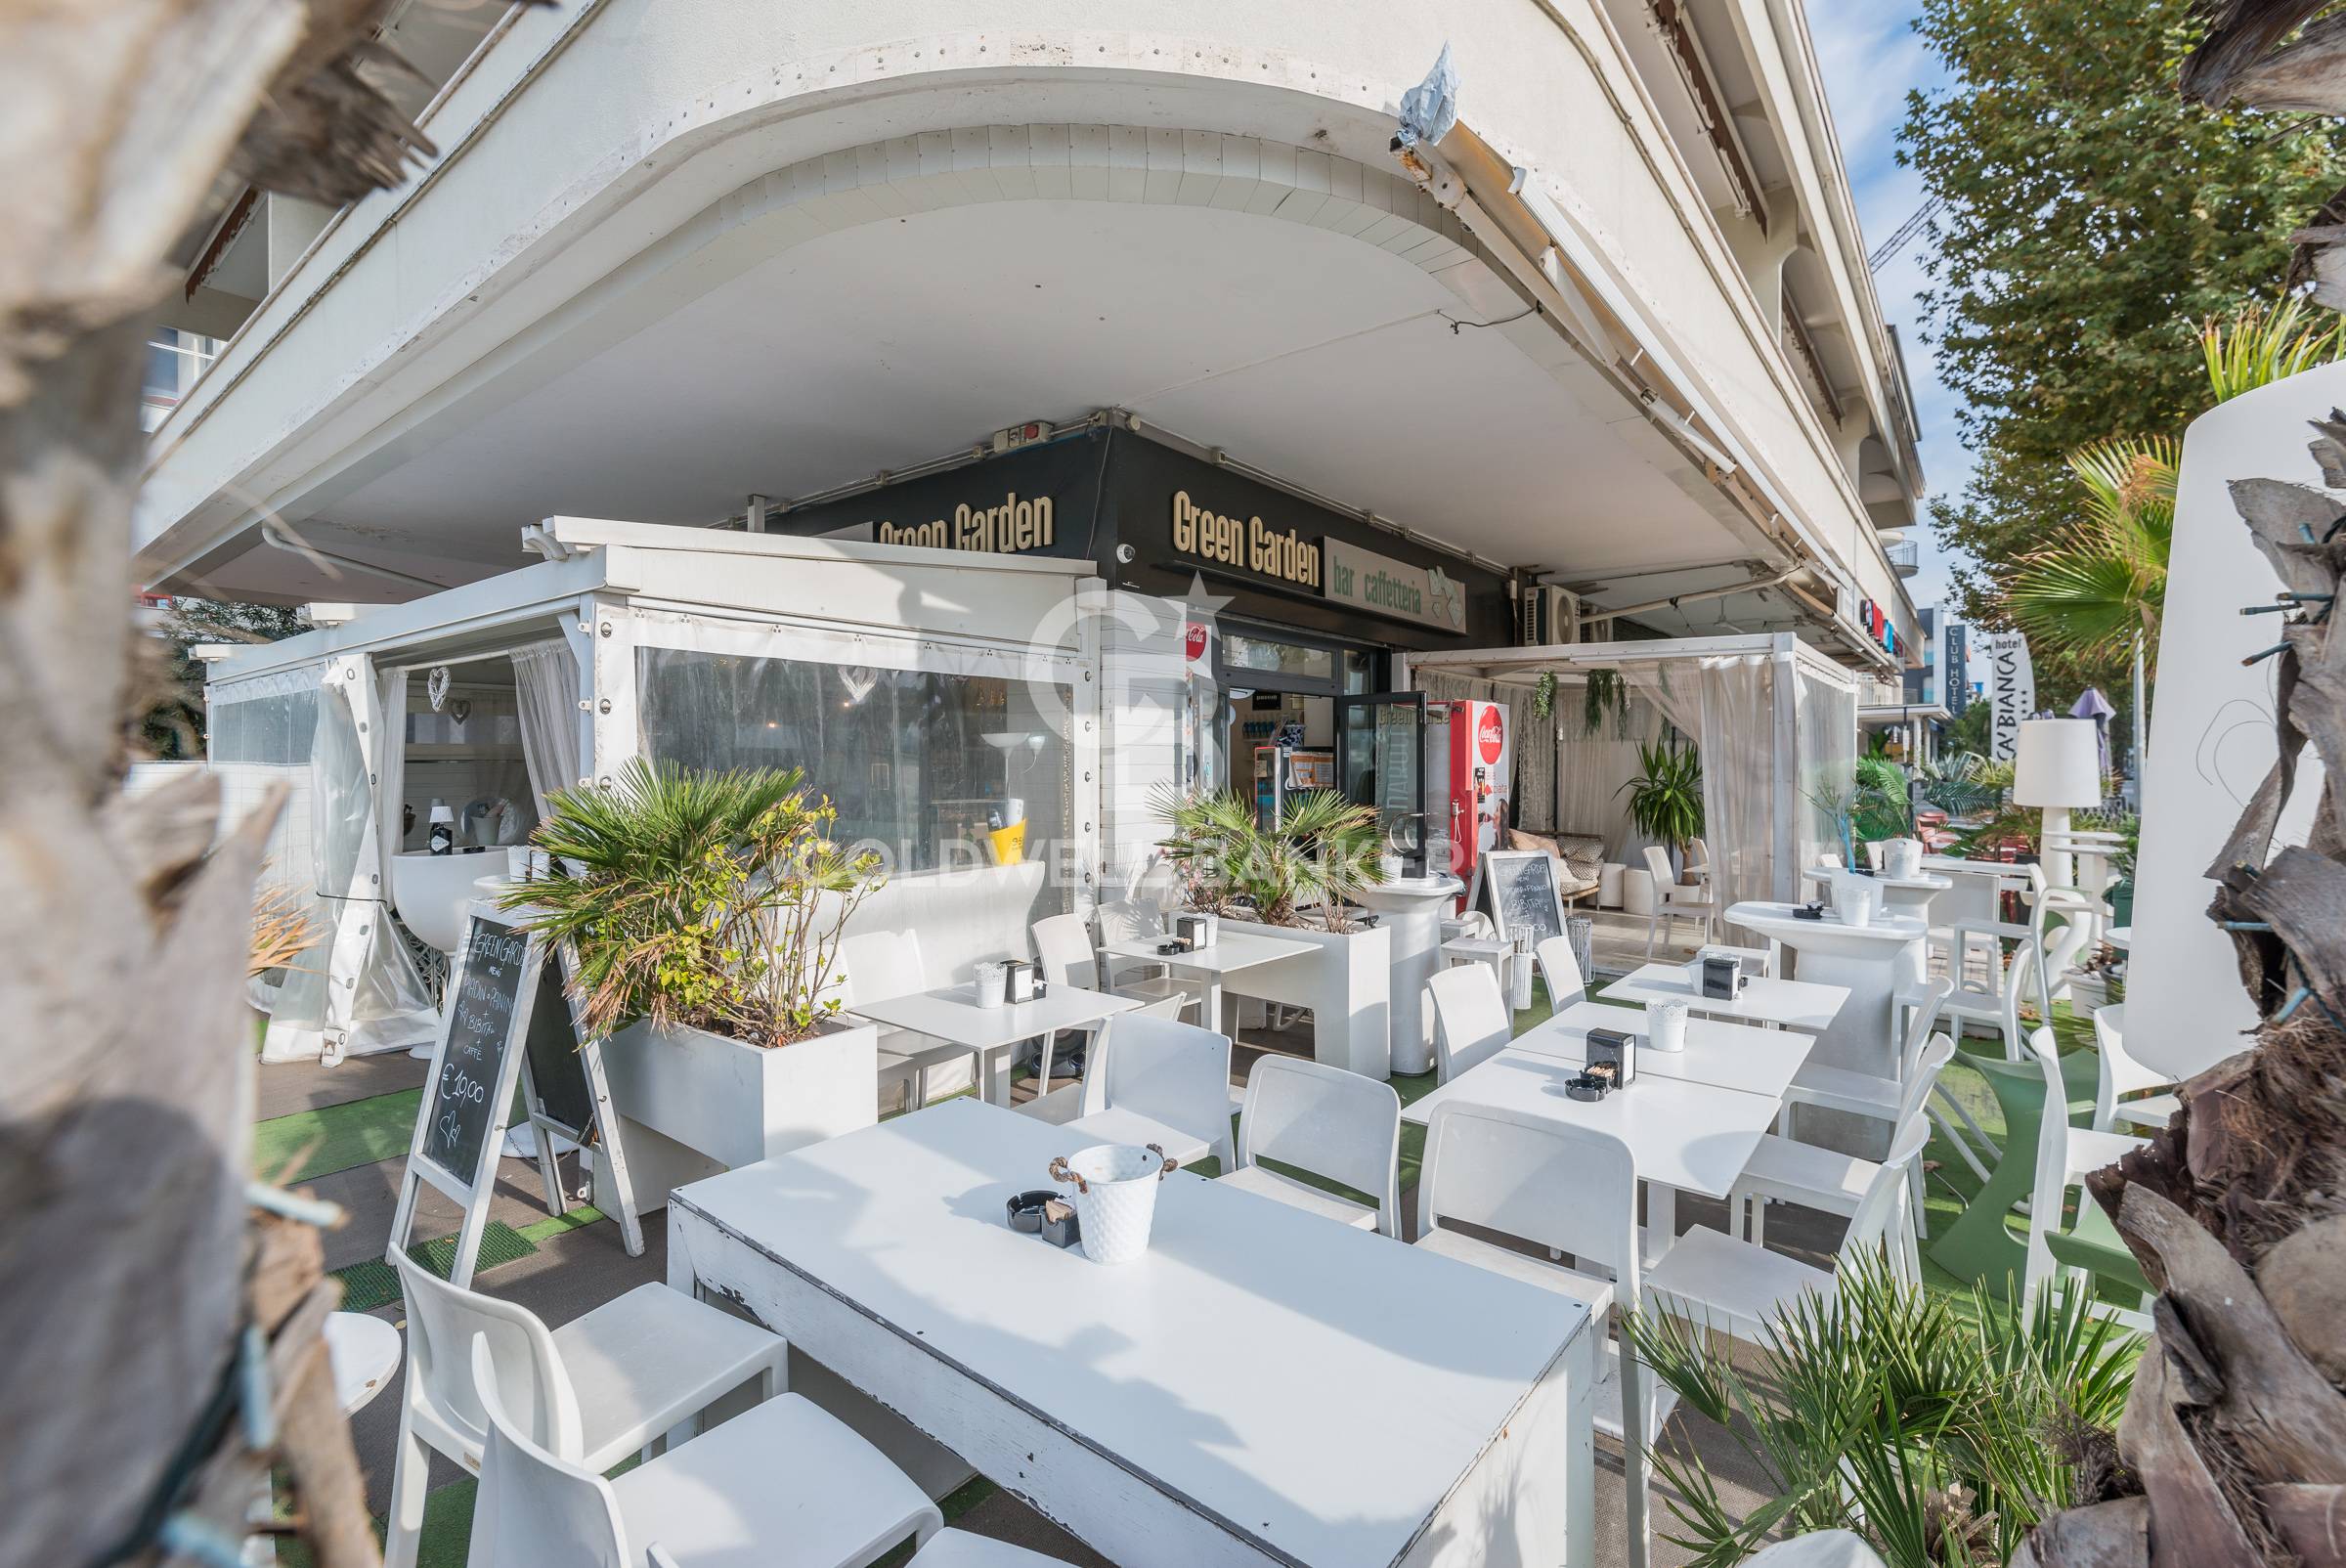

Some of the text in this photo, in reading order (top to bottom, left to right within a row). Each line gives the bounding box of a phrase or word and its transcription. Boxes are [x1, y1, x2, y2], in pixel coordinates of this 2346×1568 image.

[955, 492, 1053, 554] Garden
[1173, 490, 1320, 587] Green Garden
[1333, 554, 1422, 615] bar caffetteria
[1949, 627, 1959, 664] CLUB
[1995, 637, 2022, 650] hotel
[1948, 670, 1960, 715] HOTEL
